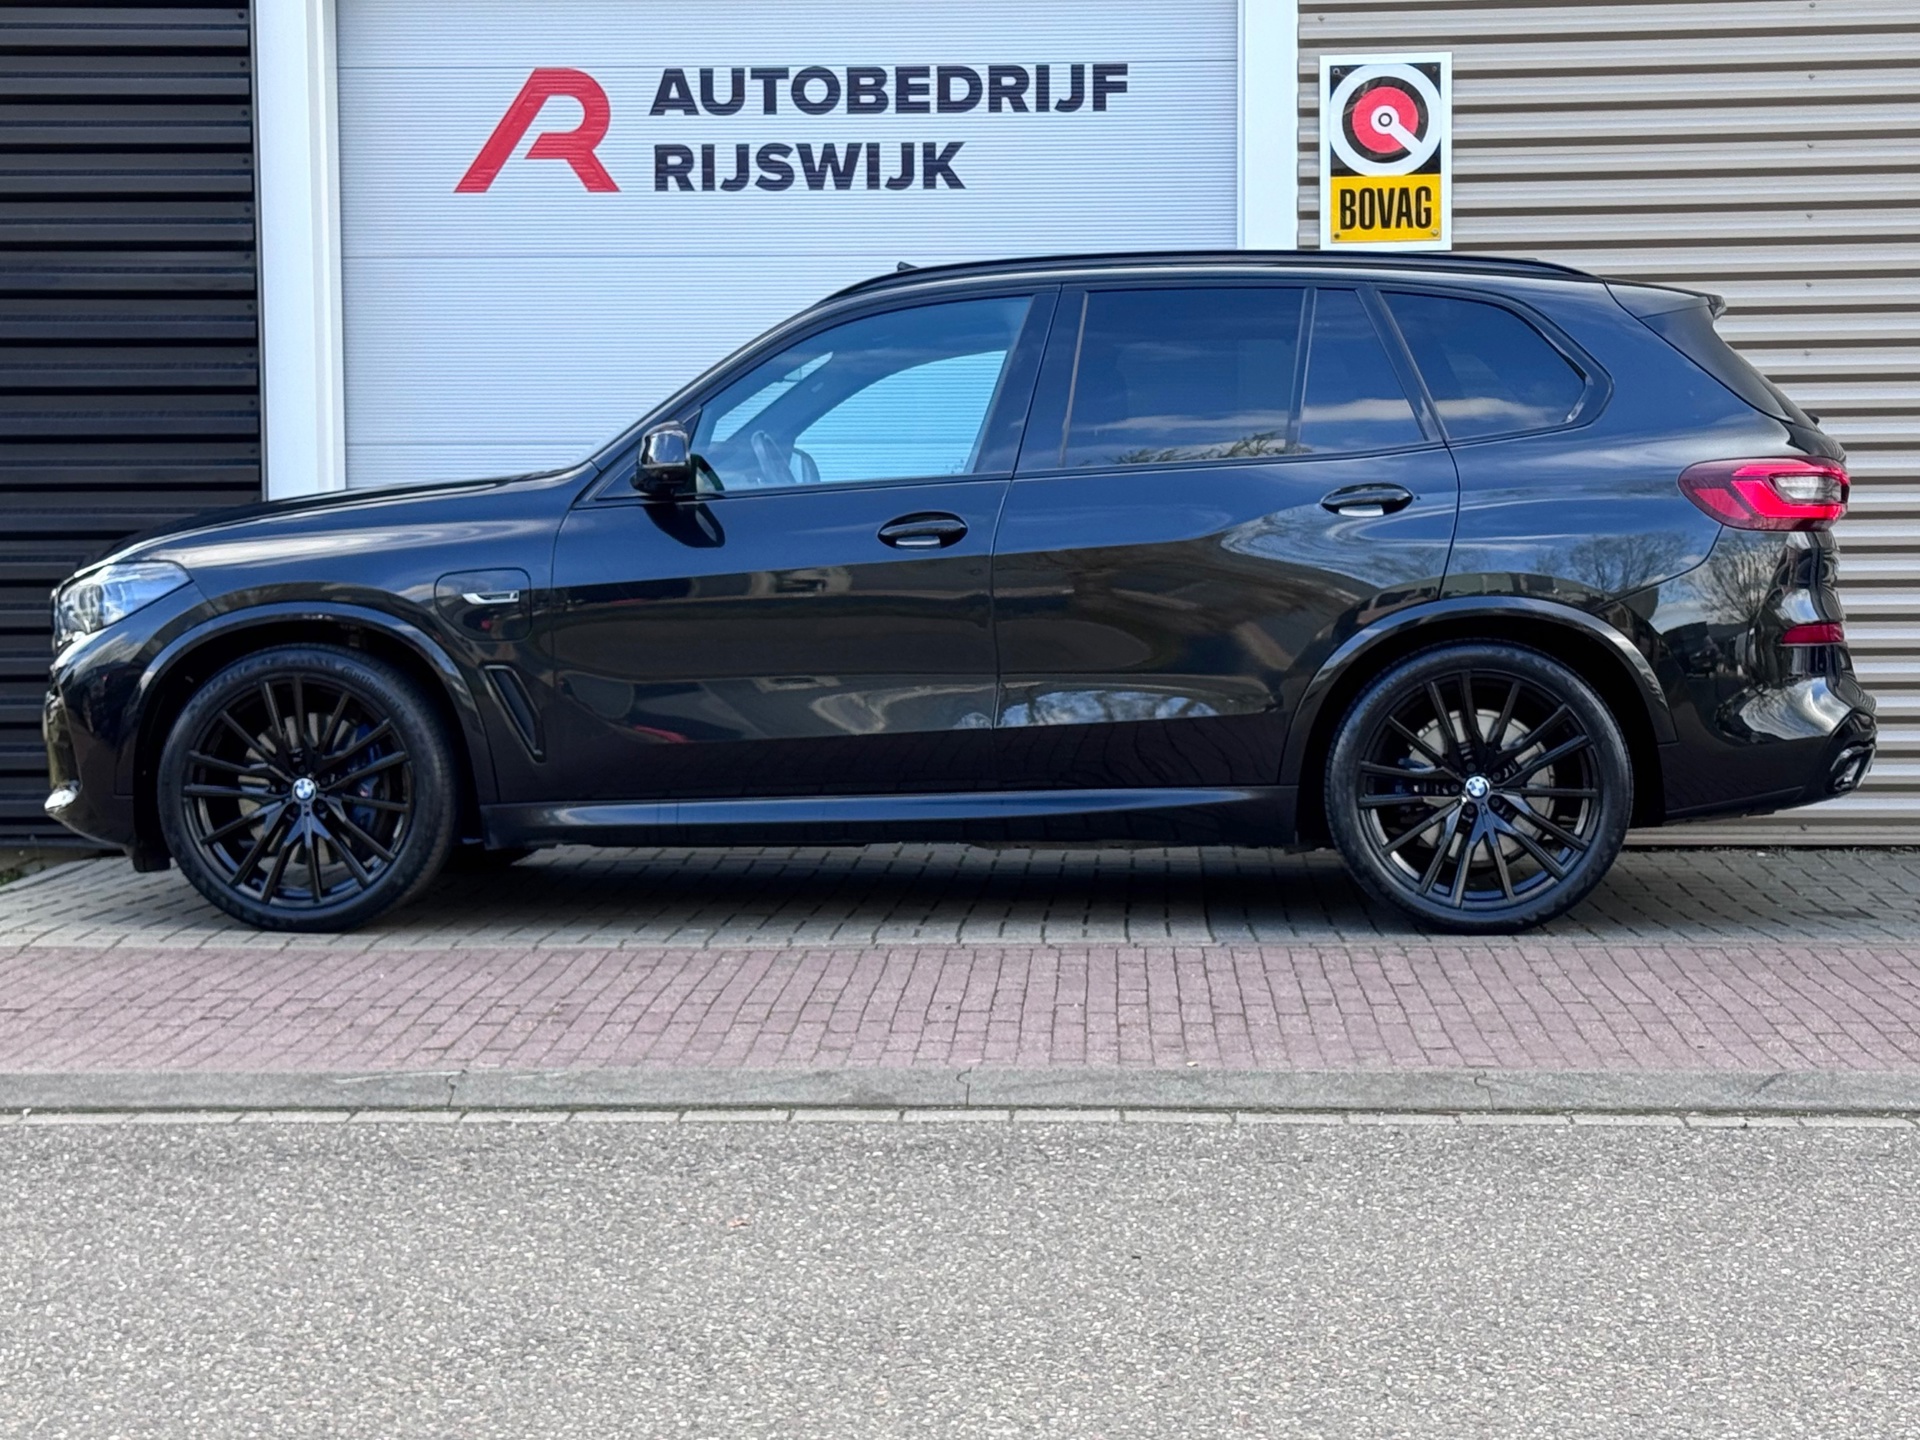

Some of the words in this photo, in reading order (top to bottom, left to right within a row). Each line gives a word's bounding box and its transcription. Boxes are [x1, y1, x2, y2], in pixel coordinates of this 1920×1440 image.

[649, 63, 1129, 116] AUTOBEDRIJF
[654, 141, 966, 192] RIJSWIJK
[1340, 186, 1432, 230] BOVAG
